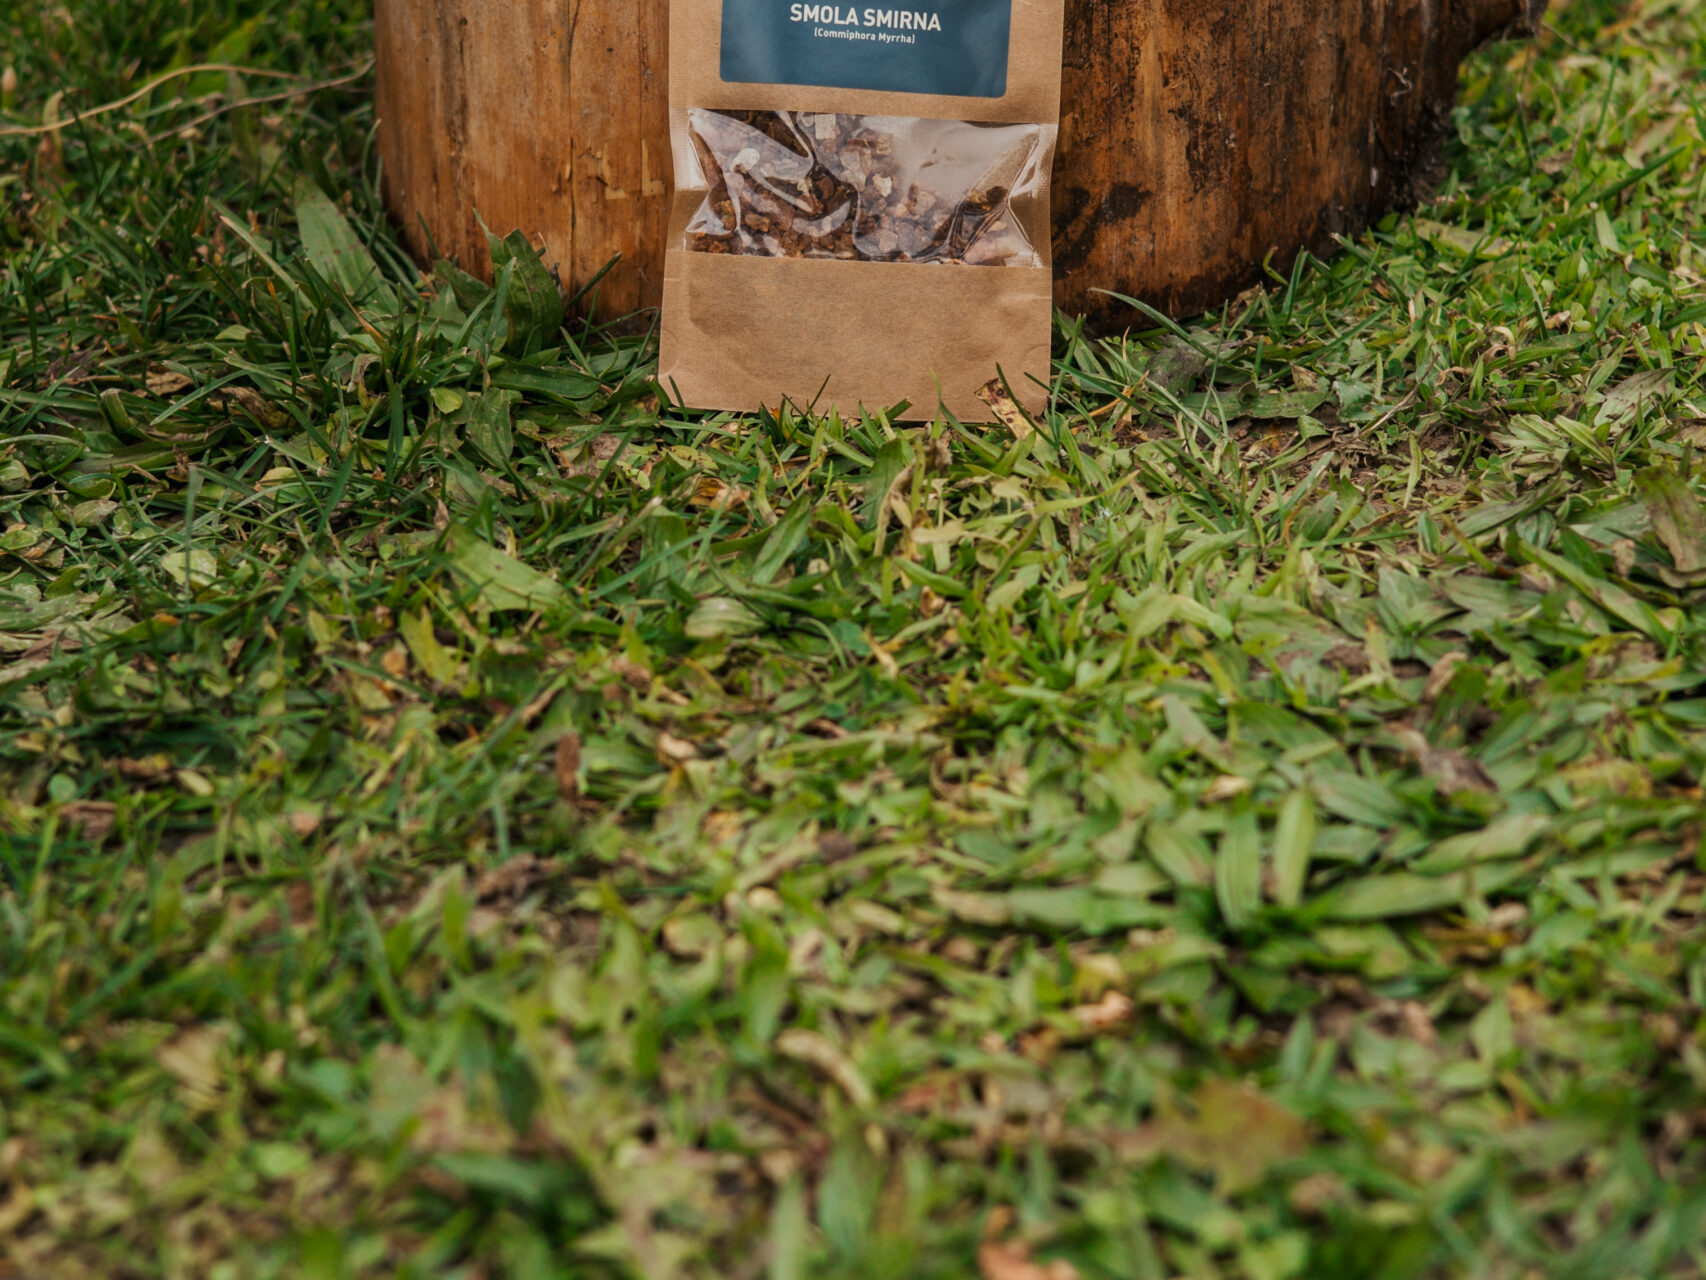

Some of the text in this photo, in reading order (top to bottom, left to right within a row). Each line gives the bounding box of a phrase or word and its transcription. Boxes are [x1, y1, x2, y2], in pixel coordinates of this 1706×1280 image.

[790, 3, 942, 32] SMOLA SMIRNA
[814, 26, 916, 44] (Commiphora Myrrha)
